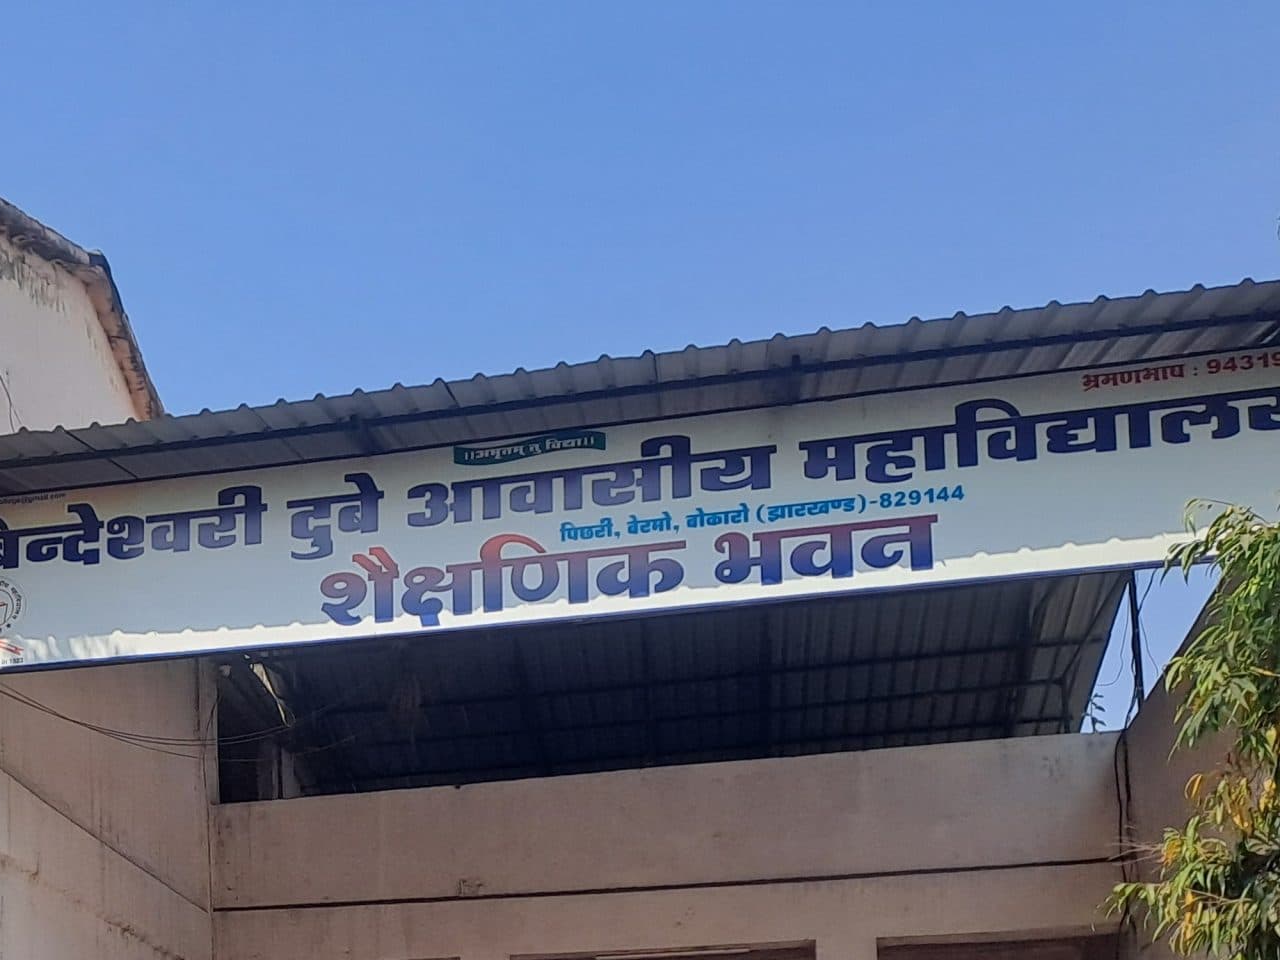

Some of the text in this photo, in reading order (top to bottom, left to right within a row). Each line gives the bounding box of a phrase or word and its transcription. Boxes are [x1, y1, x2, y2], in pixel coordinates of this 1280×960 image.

[287, 472, 385, 561] दुबे
[407, 435, 777, 528] आवासीय
[560, 518, 621, 543] पिछरी,
[320, 514, 939, 627] शैक्षणिक भवन
